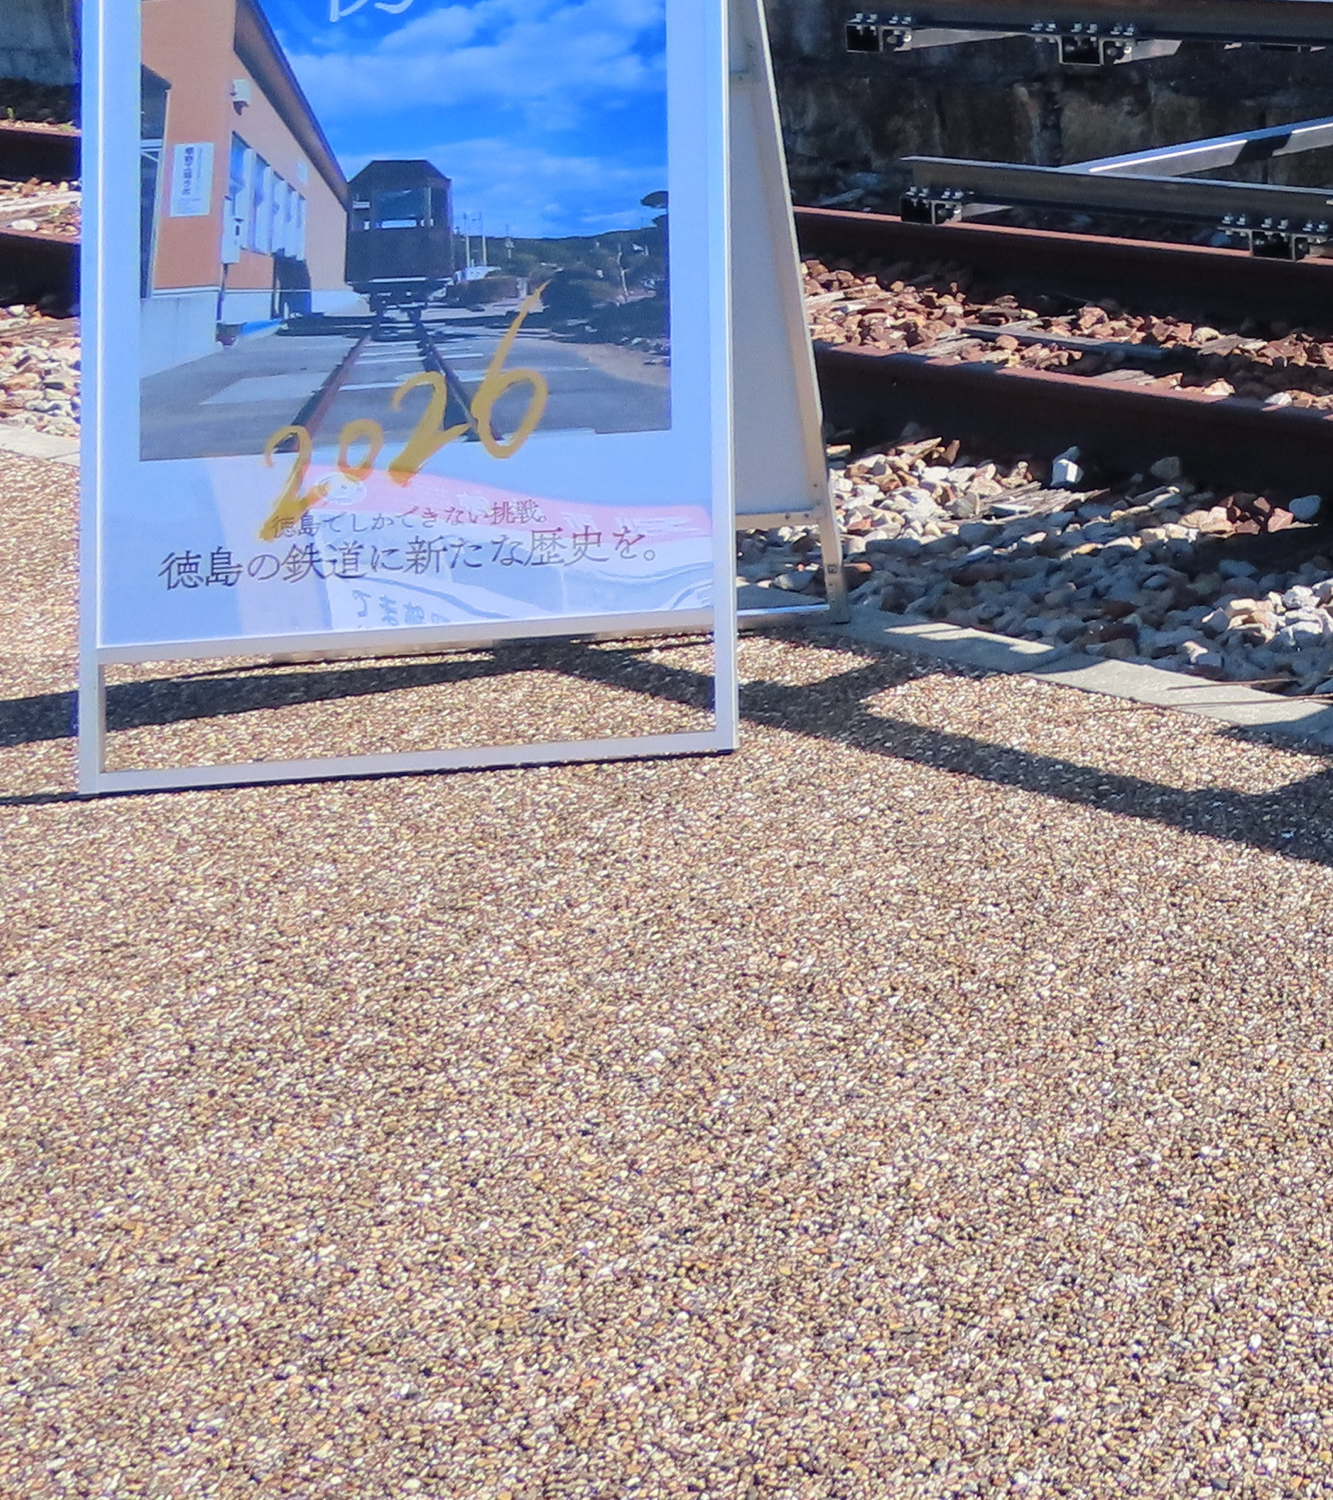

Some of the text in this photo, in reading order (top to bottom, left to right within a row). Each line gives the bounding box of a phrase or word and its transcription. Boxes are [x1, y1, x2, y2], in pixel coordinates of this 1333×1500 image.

[258, 280, 549, 542] 2026
[157, 526, 656, 591] 徳島の鉄道に新たな歴史を。
